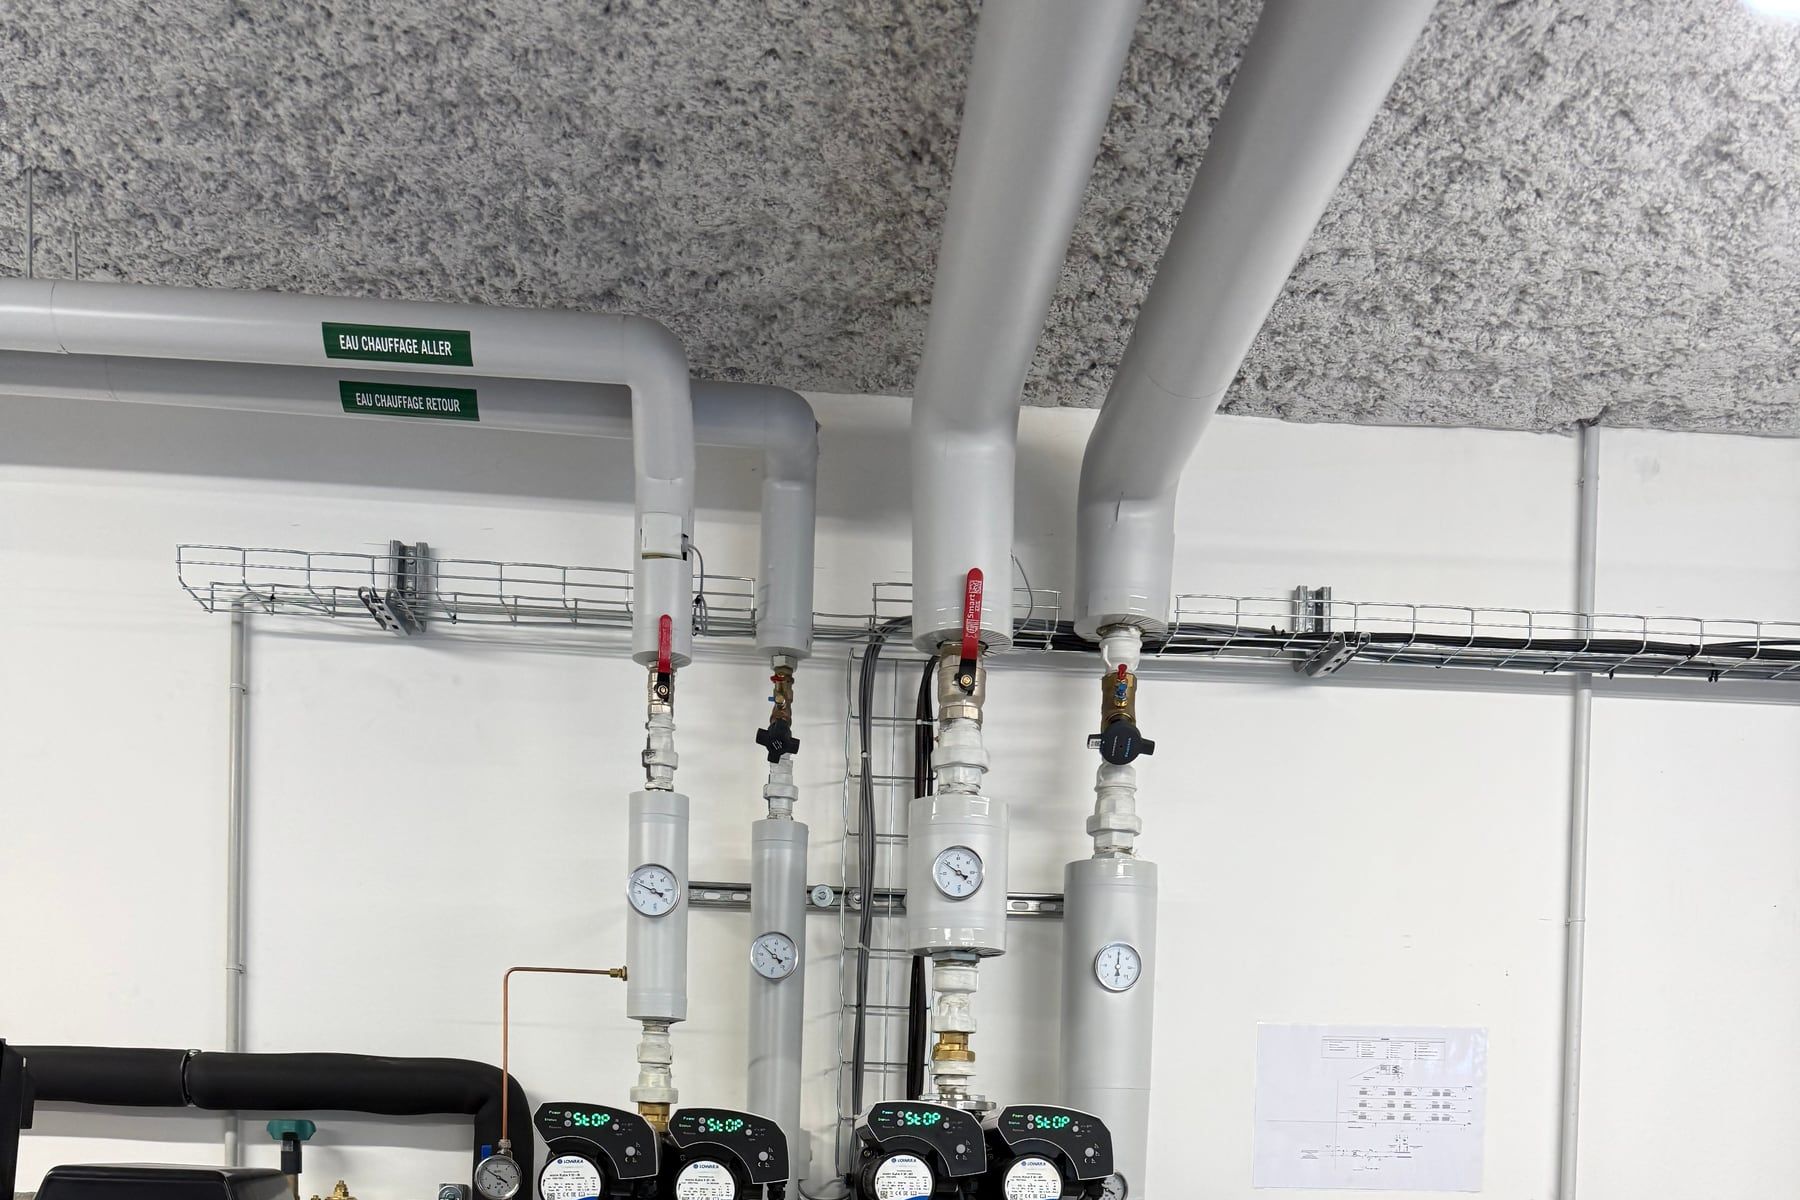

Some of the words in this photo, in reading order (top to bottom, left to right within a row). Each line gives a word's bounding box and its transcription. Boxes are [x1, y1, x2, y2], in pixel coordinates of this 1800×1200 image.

[339, 334, 359, 350] EAU
[361, 335, 419, 354] CHAUFFAGE
[421, 339, 452, 356] ALLER
[355, 392, 373, 406] EAU
[374, 393, 424, 410] CHAUFFAGE
[426, 397, 461, 413] RETOUR
